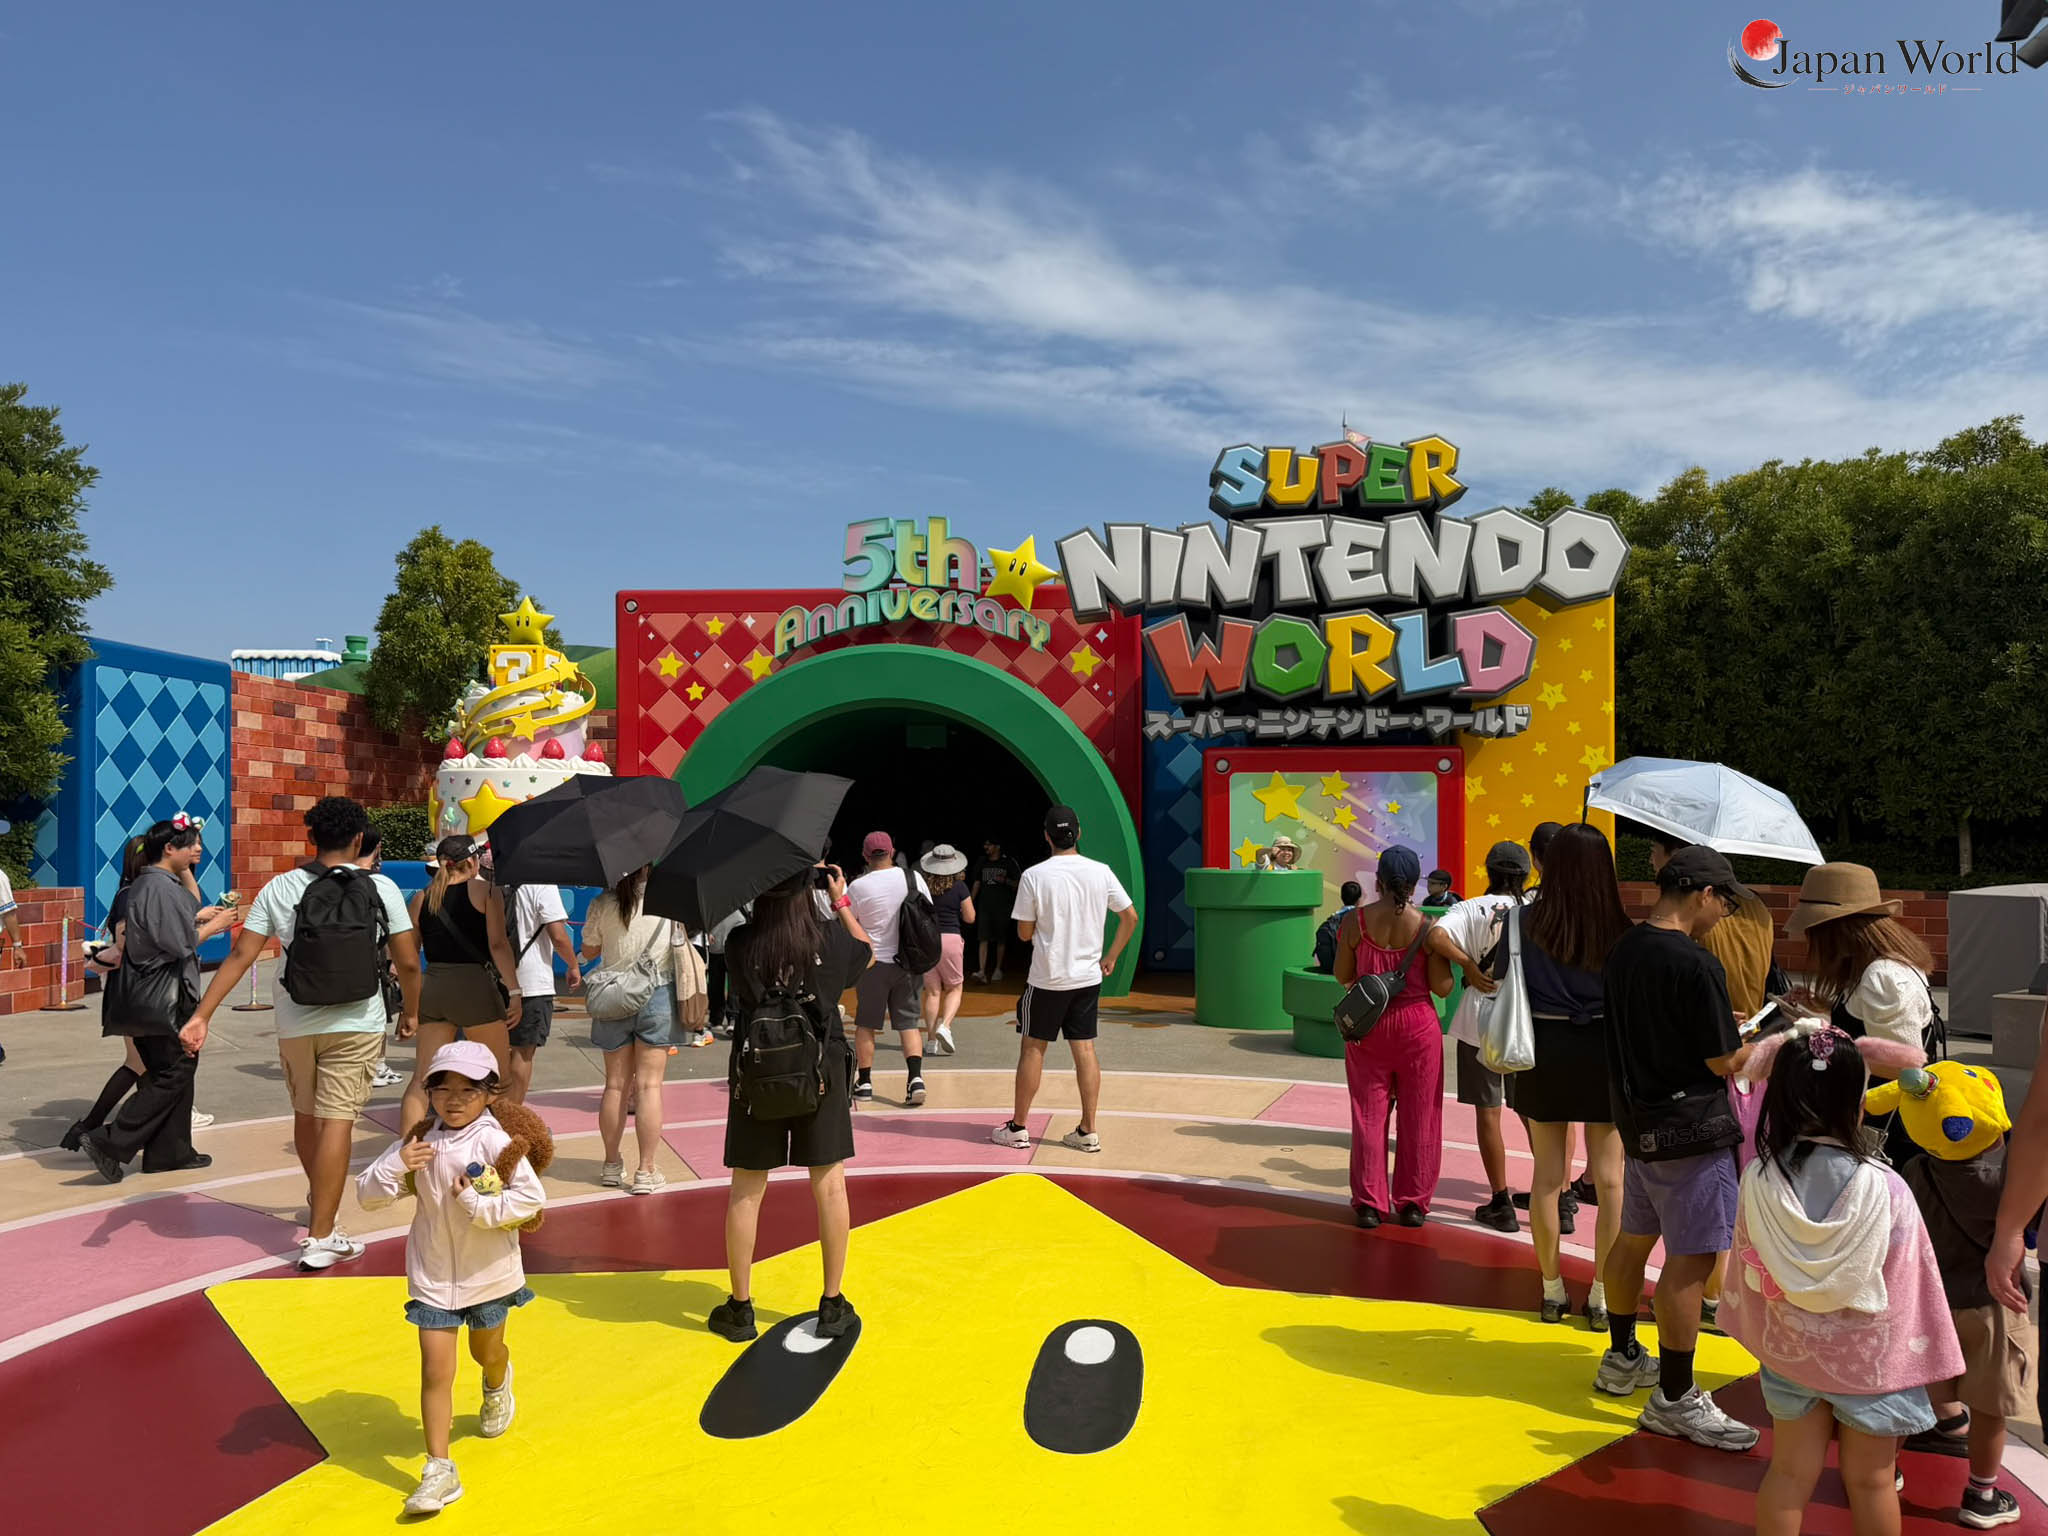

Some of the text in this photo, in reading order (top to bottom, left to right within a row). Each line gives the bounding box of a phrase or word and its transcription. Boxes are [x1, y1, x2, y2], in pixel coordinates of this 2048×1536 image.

[1211, 434, 1467, 517] SUPER
[842, 516, 983, 593] 5th
[1056, 505, 1631, 622] NINTENDO
[775, 587, 1051, 659] Anniversary
[1142, 605, 1537, 699] WORLD
